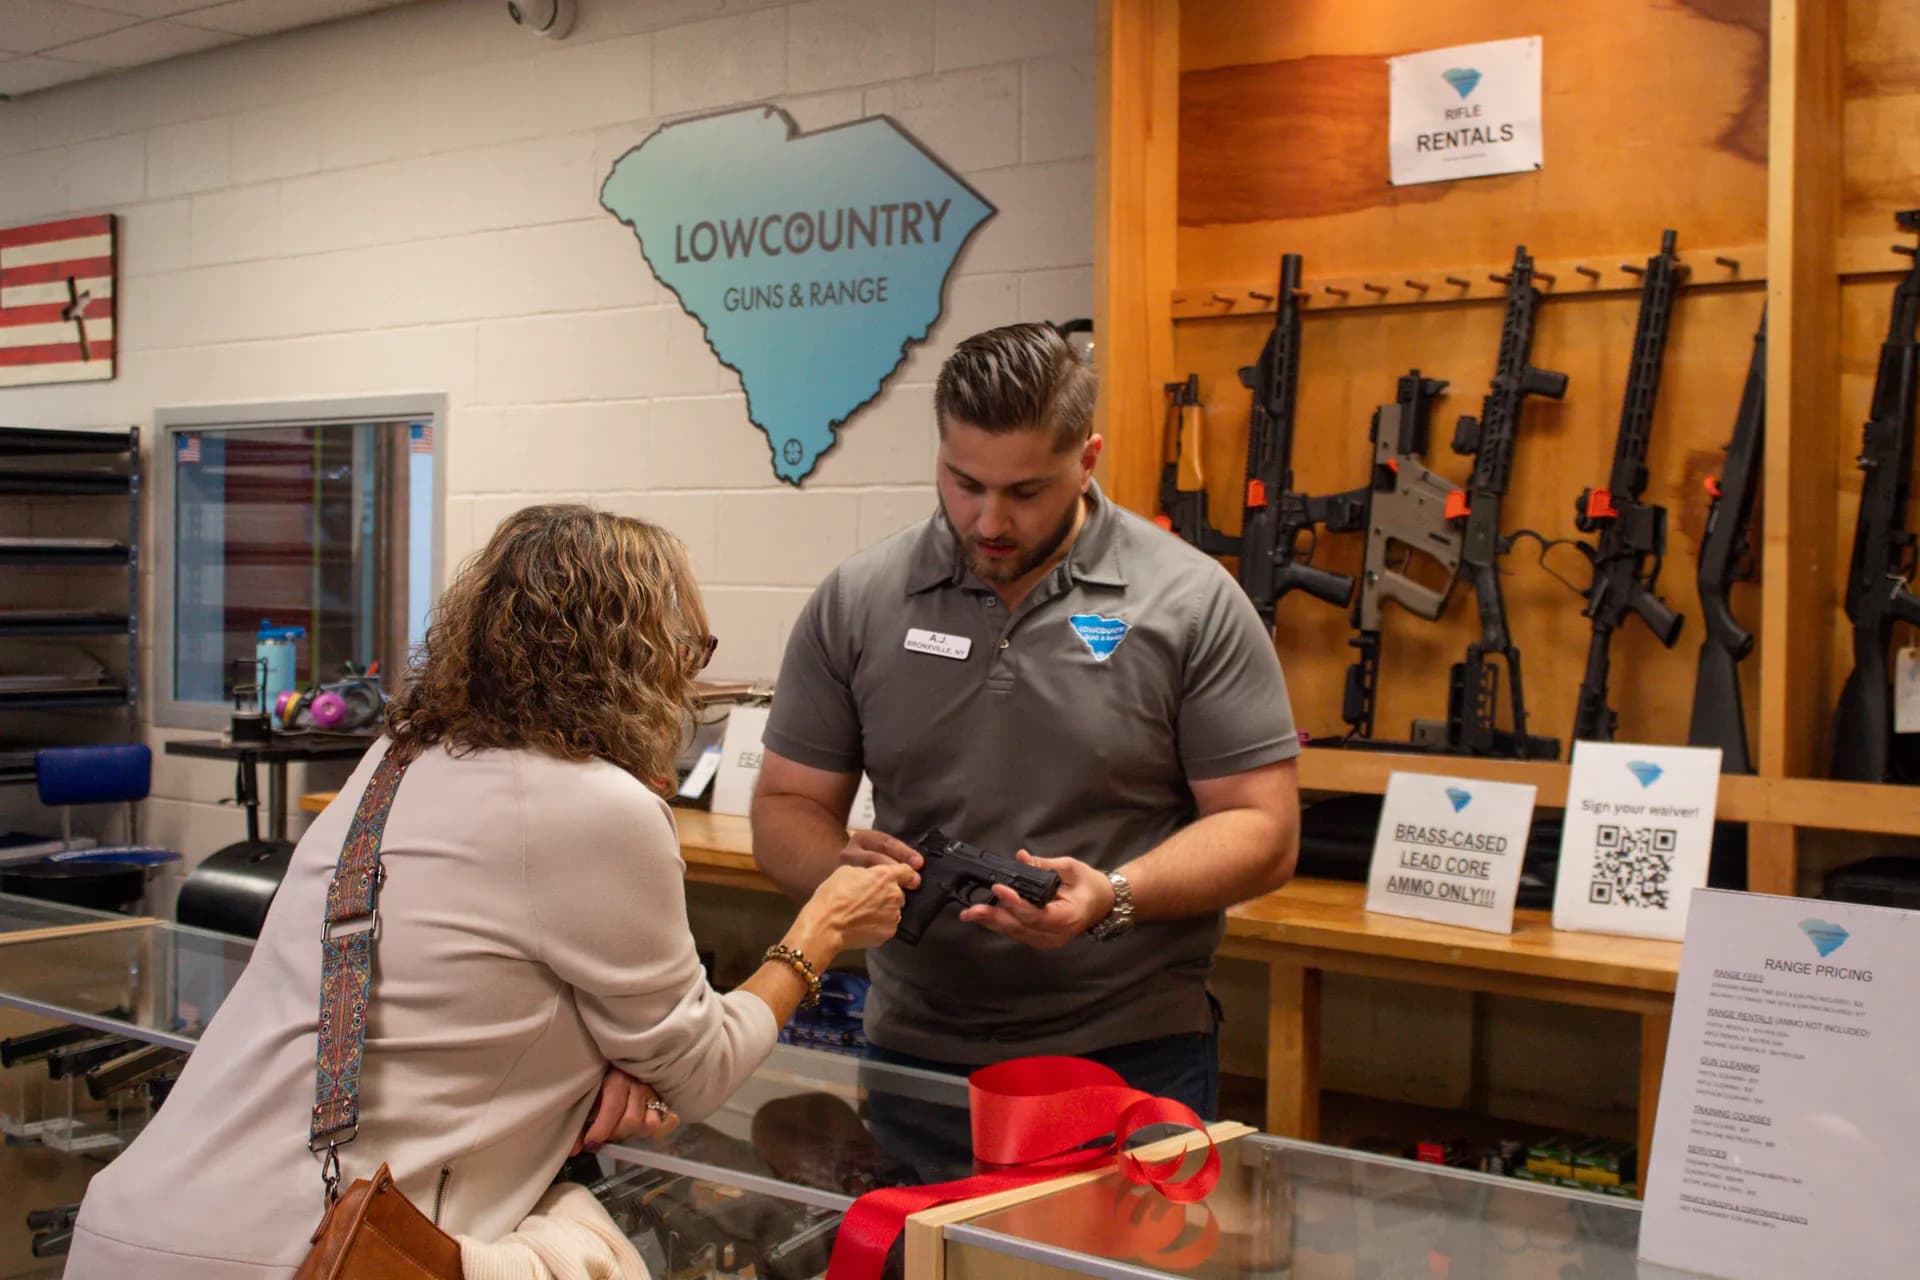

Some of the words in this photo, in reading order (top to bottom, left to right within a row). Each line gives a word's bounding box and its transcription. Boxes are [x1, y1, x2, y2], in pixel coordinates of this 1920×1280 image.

[1444, 104, 1482, 121] RIFLE
[1416, 123, 1514, 153] RENTALS
[674, 198, 952, 264] LOWCOUNTRY
[723, 283, 784, 312] GUNS
[788, 283, 804, 308] &
[809, 276, 889, 306] RANGE
[1582, 799, 1611, 816] Sign
[1614, 803, 1645, 818] your
[1649, 806, 1699, 819] waiver!
[1395, 823, 1507, 855] BRASS-CASED
[1401, 851, 1442, 872] LEAD
[1445, 857, 1491, 878] CORE
[1387, 876, 1433, 898] AMMO
[1438, 882, 1496, 908] ONLY!!!
[1713, 969, 1742, 981] RANGE
[1764, 958, 1813, 976] RANGE
[1815, 965, 1873, 983] PRICING
[1707, 1008, 1736, 1020] RANGE
[1736, 1012, 1774, 1025] RENTALS
[1774, 1016, 1804, 1029] (AMMO
[1804, 1021, 1823, 1031] NOT
[1719, 1059, 1760, 1074] CLEANING
[1693, 1105, 1731, 1119] TRAINING
[1732, 1111, 1772, 1126] COURSES
